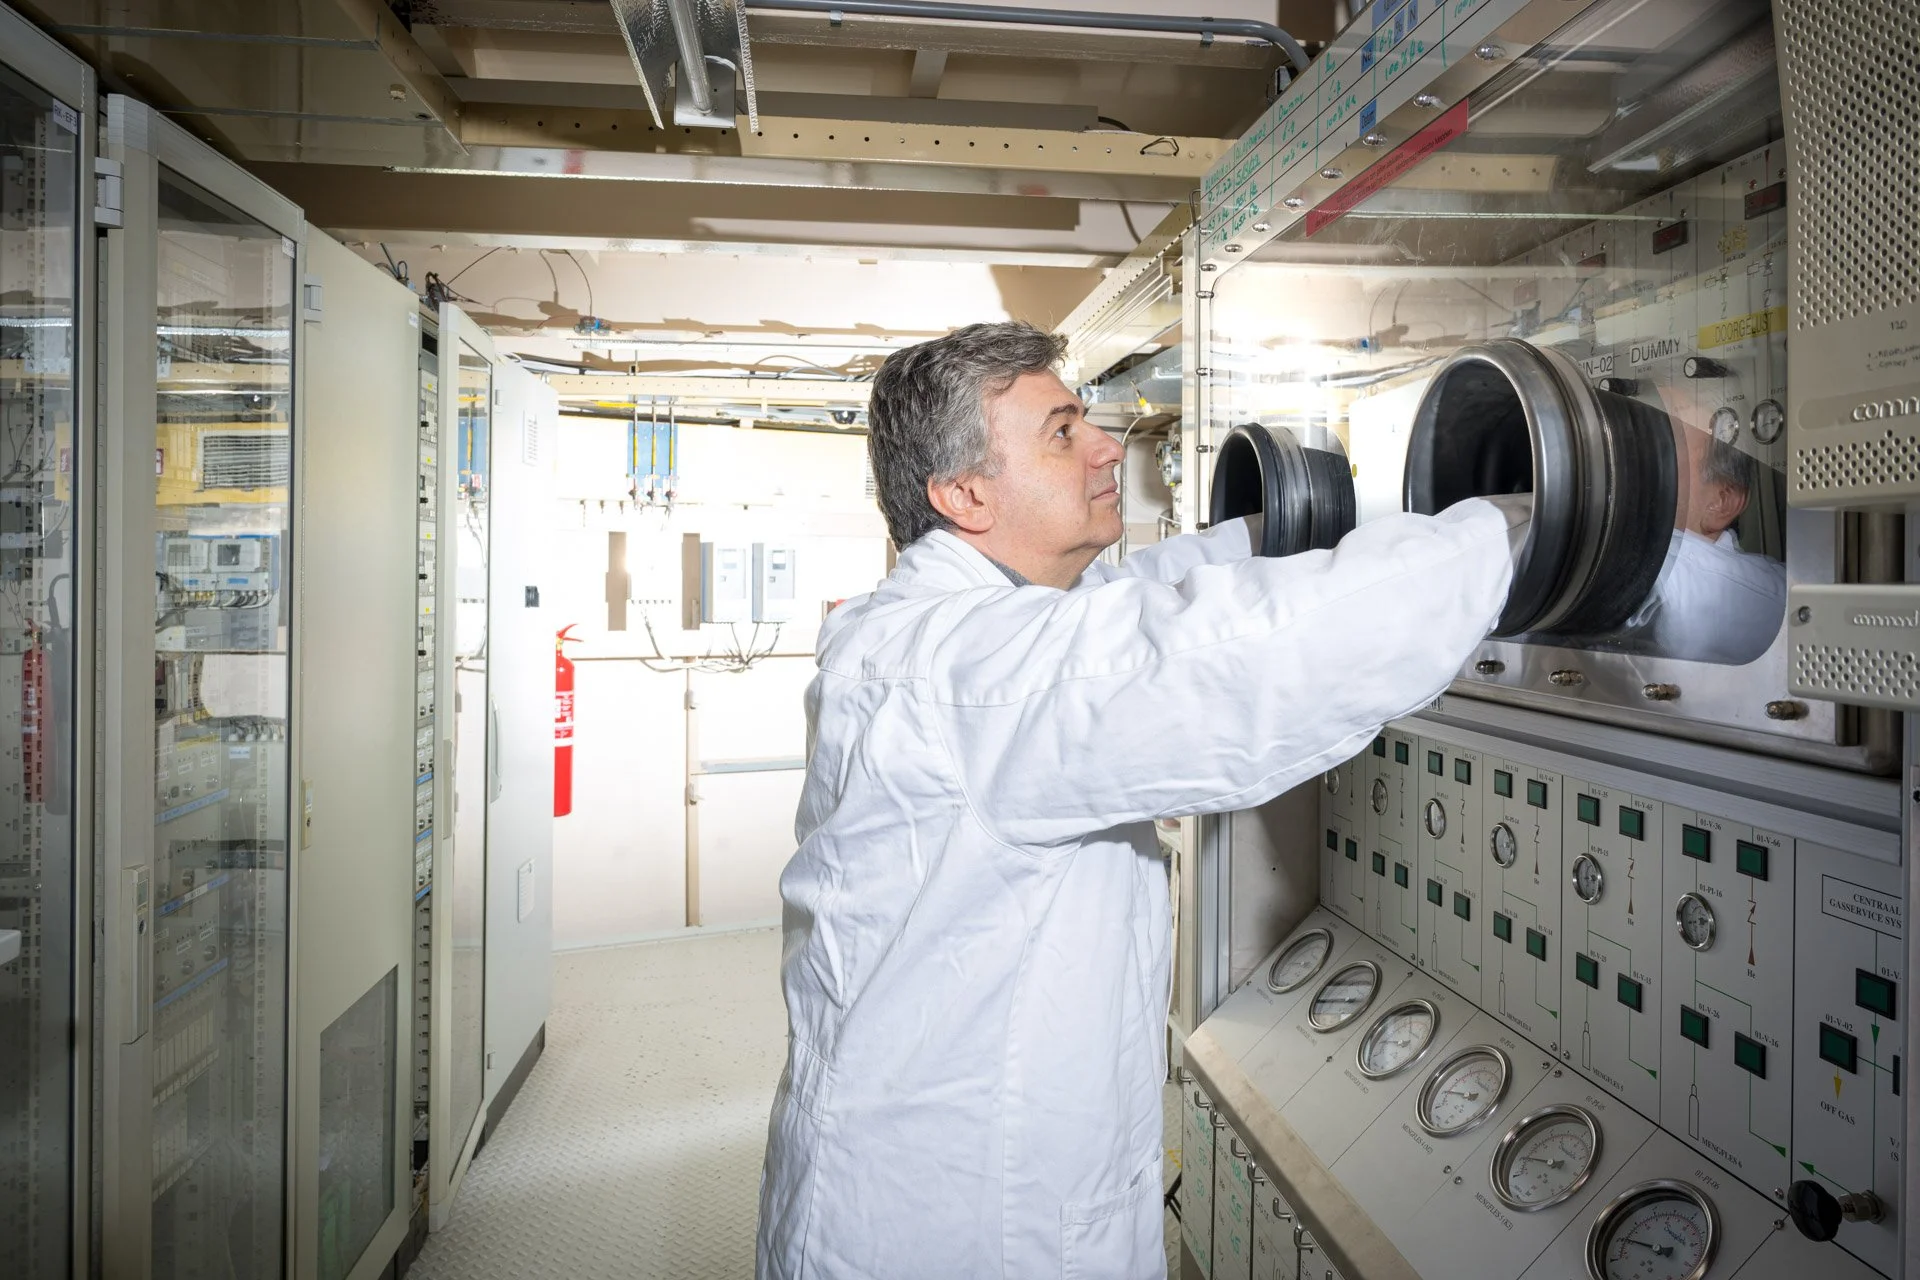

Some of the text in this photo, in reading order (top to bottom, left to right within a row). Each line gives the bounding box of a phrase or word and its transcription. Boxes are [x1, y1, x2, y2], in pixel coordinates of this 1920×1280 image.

[1631, 337, 1681, 364] DUMMY
[1699, 818, 1722, 831] 01-V-36
[1756, 834, 1781, 848] 01-V-66
[1699, 883, 1723, 898] 01-PI-16
[1829, 898, 1883, 923] GASSERVICE
[1853, 894, 1902, 916] CENTRAAL
[1747, 968, 1756, 979] He
[1698, 1003, 1720, 1019] 01-V-26
[1825, 1013, 1853, 1032] 01-V-02
[1755, 1030, 1779, 1048] 01-V-16
[1592, 1066, 1620, 1090] MENGFLES
[1820, 1100, 1855, 1126] OFF GAS
[1702, 1136, 1738, 1166] MENGFLES
[1475, 1191, 1499, 1217] MENGFLES
